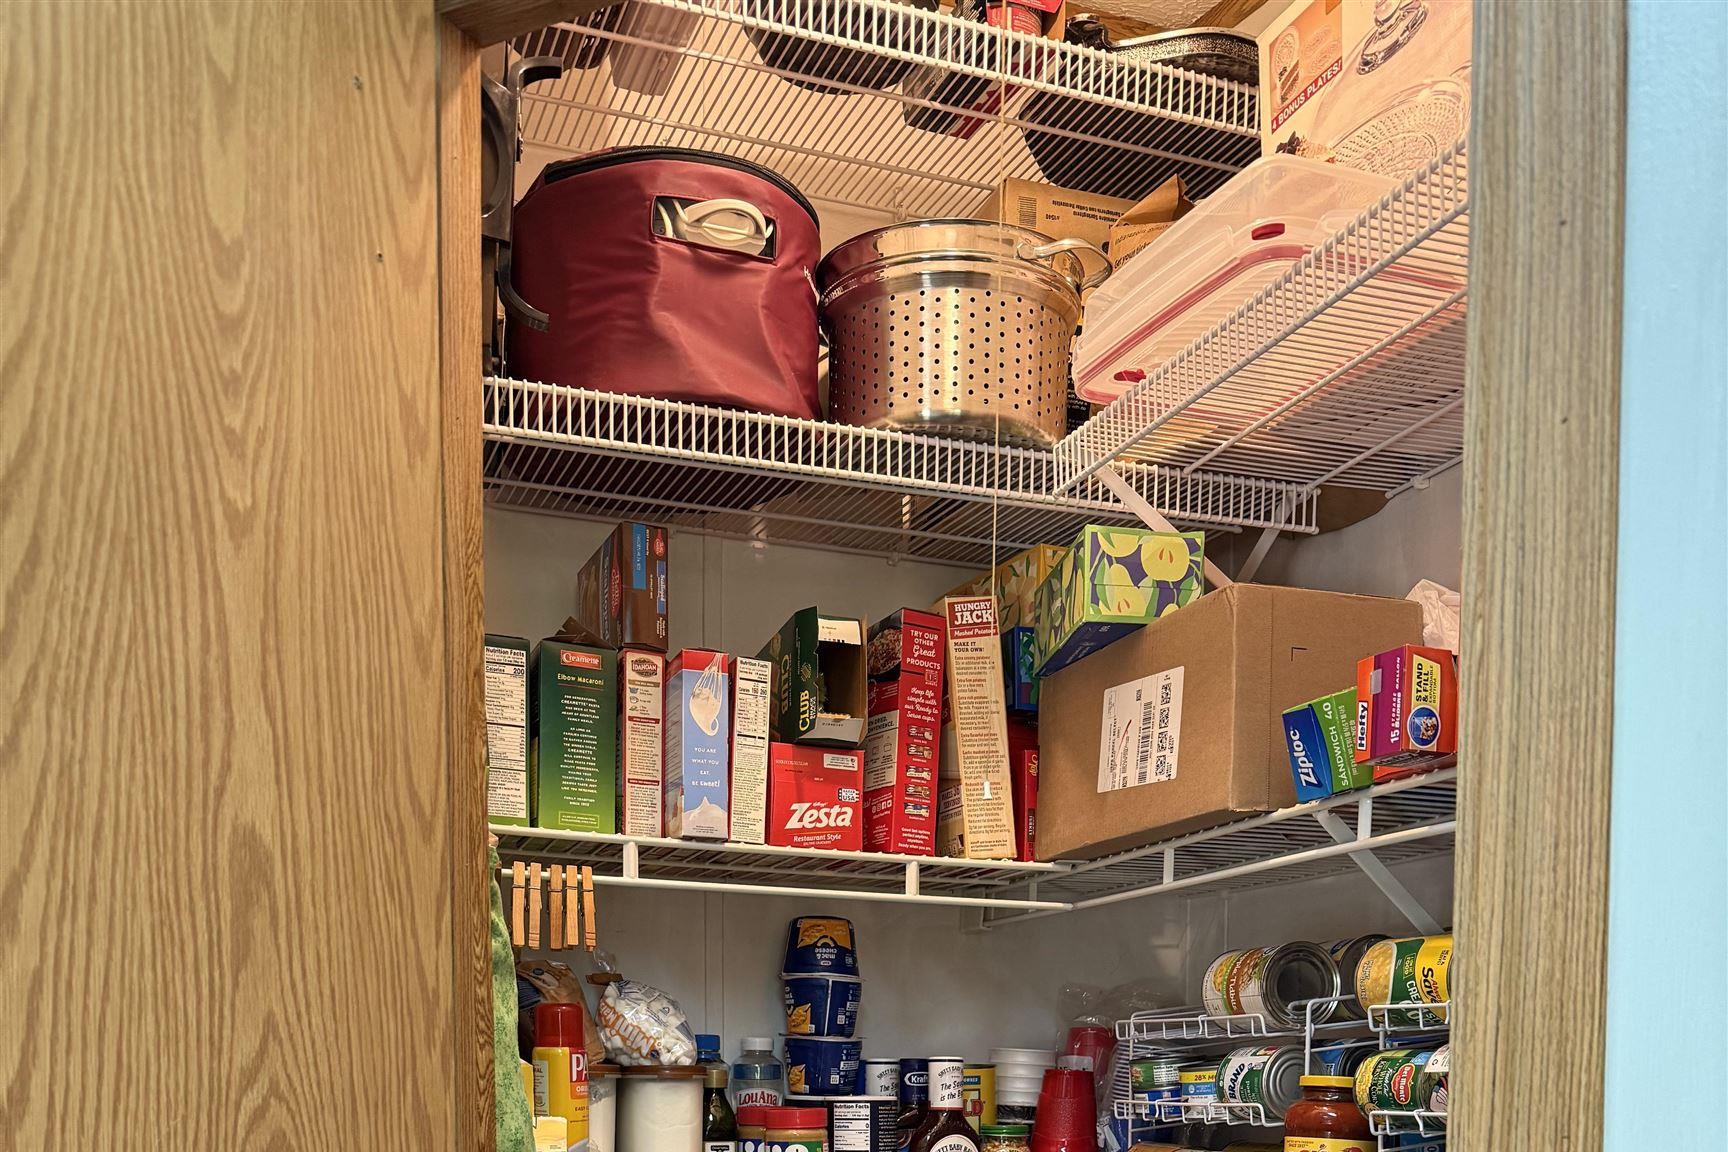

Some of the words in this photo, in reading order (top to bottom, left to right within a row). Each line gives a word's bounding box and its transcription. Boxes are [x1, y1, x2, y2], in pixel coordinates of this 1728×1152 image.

[1278, 93, 1306, 125] BONUS
[1306, 59, 1342, 98] PLATES!
[954, 601, 991, 612] HUNGRY
[954, 609, 993, 625] JACK
[924, 633, 938, 641] OUR
[954, 629, 973, 637] Mashed
[914, 638, 933, 646] OTHER
[485, 647, 509, 656] Nutrition
[509, 649, 525, 657] Facts
[913, 644, 936, 658] Great
[563, 653, 600, 665] Creamette
[906, 658, 941, 670] PRODUCTS
[513, 667, 525, 675] 200
[633, 663, 657, 672] IDAHOAN
[557, 673, 575, 681] Elbow
[577, 676, 604, 685] Macaroni
[911, 687, 925, 696] Keep
[925, 689, 934, 698] life
[907, 696, 924, 704] simple
[925, 698, 937, 706] with
[799, 689, 810, 731] CLUB
[907, 711, 921, 719] Serve
[915, 704, 932, 714] Ready
[1322, 702, 1332, 719] 40
[1357, 703, 1368, 748] Hefty
[1390, 729, 1400, 744] 15
[1289, 728, 1319, 788] Ziploc
[1328, 726, 1349, 787] SANDWICH
[784, 801, 853, 830] Zesta
[793, 834, 826, 842] Restaurant
[826, 833, 842, 841] Style
[571, 1053, 589, 1082] PA
[941, 1082, 951, 1091] The
[1229, 1063, 1246, 1099] BRAND
[1376, 1071, 1386, 1095] WHOLE
[880, 1084, 890, 1092] The
[1398, 1077, 1408, 1102] Monte
[738, 1091, 778, 1106] LouAna
[947, 1091, 956, 1099] the
[949, 1143, 962, 1151] BABY
